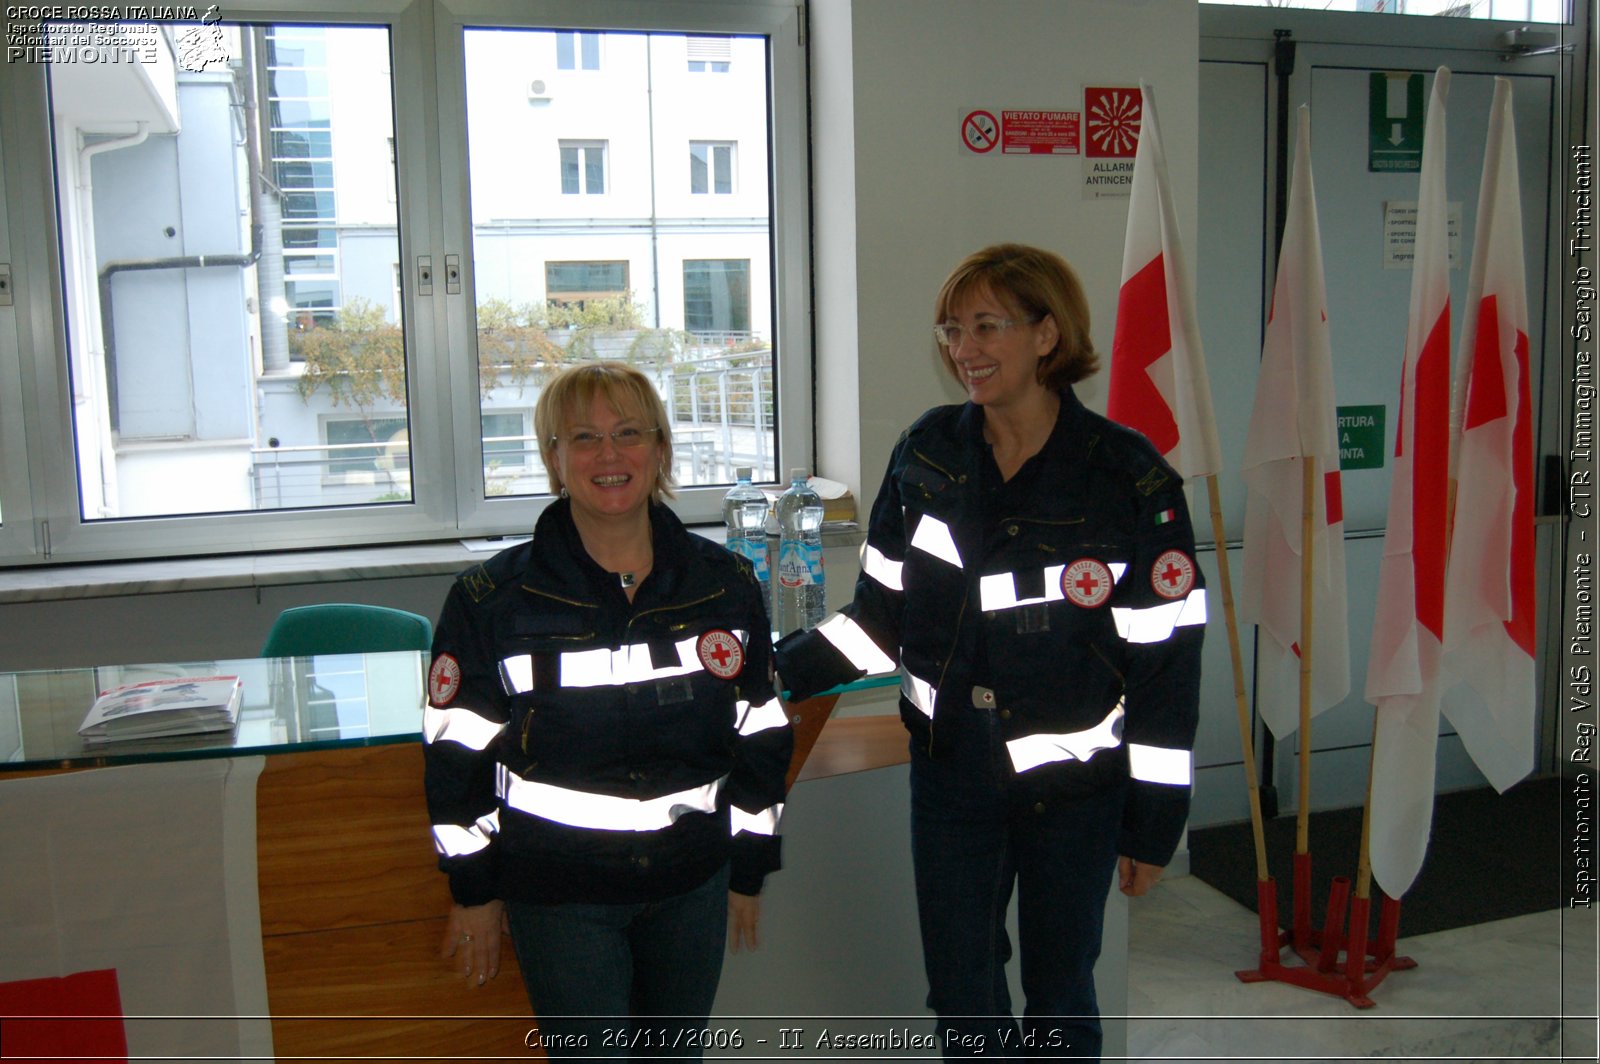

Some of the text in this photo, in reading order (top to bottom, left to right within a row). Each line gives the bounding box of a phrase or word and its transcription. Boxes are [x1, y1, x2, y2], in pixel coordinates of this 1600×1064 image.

[1004, 112, 1079, 121] VIETATO FUMARE
[1093, 163, 1134, 172] ALLARM
[1086, 176, 1132, 185] ANTINCEN
[1338, 415, 1375, 428] RTURA
[1342, 432, 1350, 443] A
[1340, 448, 1365, 460] INTA
